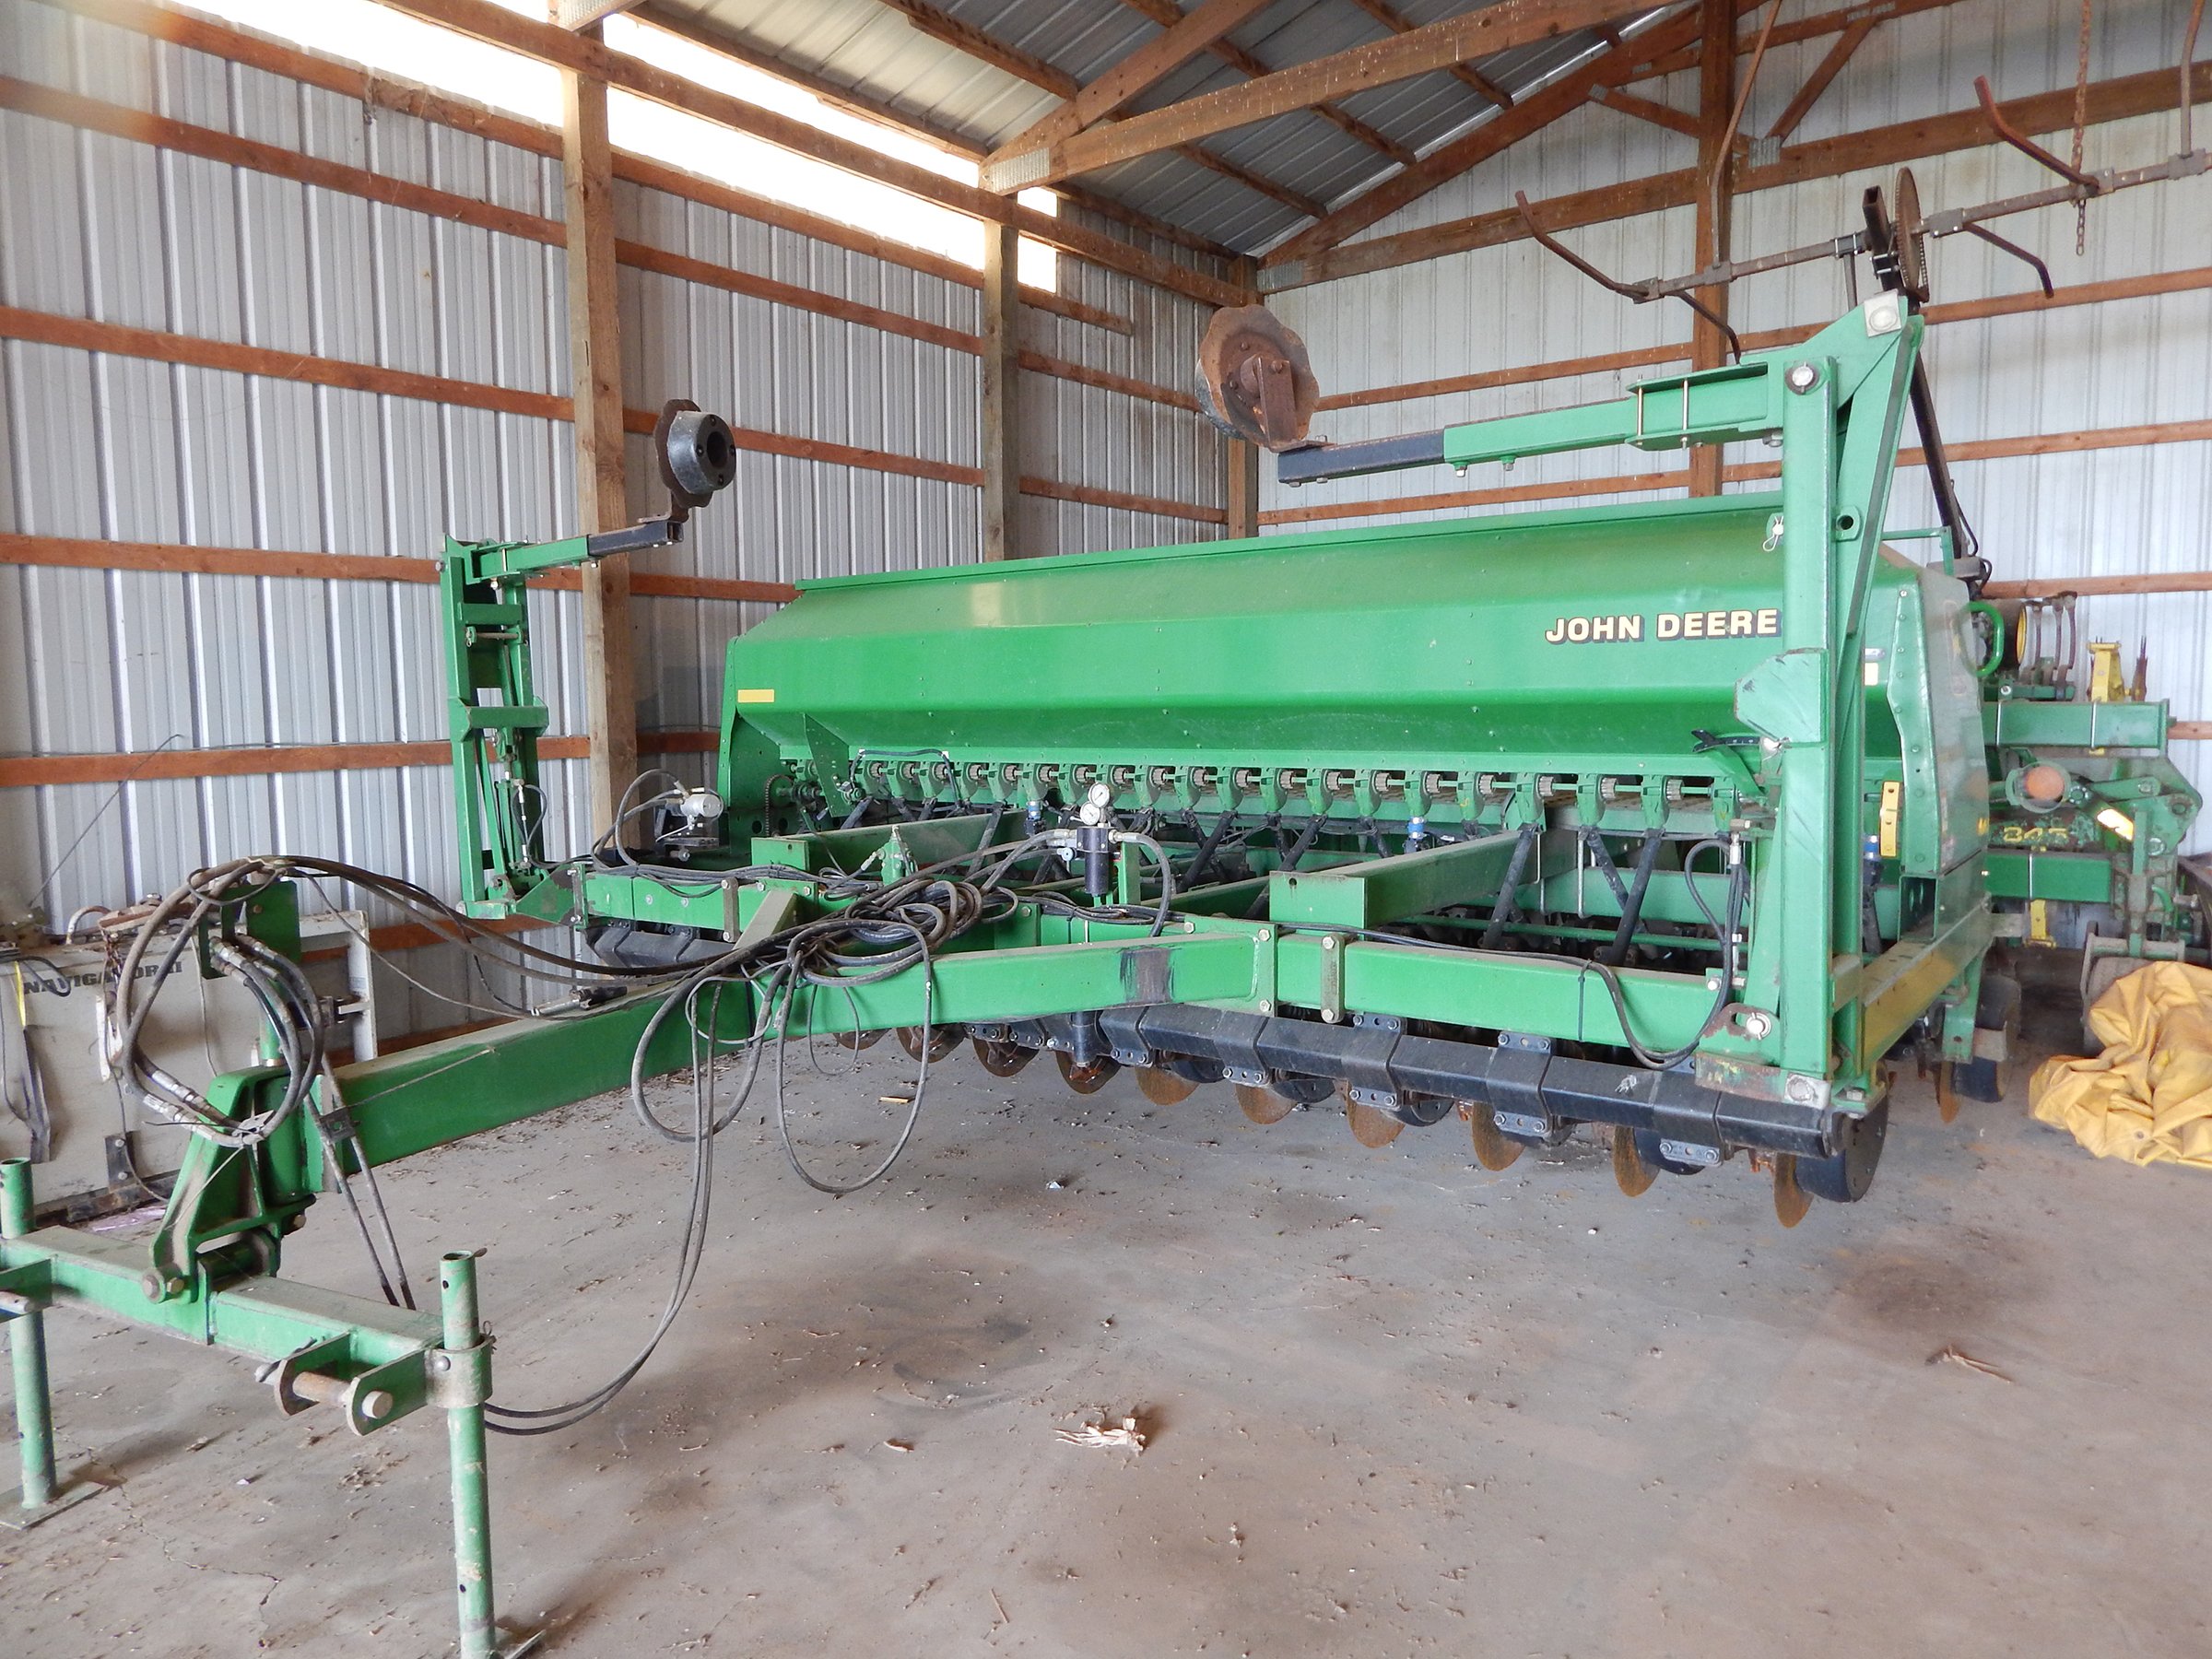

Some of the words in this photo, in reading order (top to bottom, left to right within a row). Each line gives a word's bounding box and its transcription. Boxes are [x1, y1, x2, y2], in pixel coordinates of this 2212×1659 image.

[1545, 614, 1644, 645] JOHN
[1656, 608, 1783, 642] DEERE
[24, 964, 160, 994] NAVIGAOR
